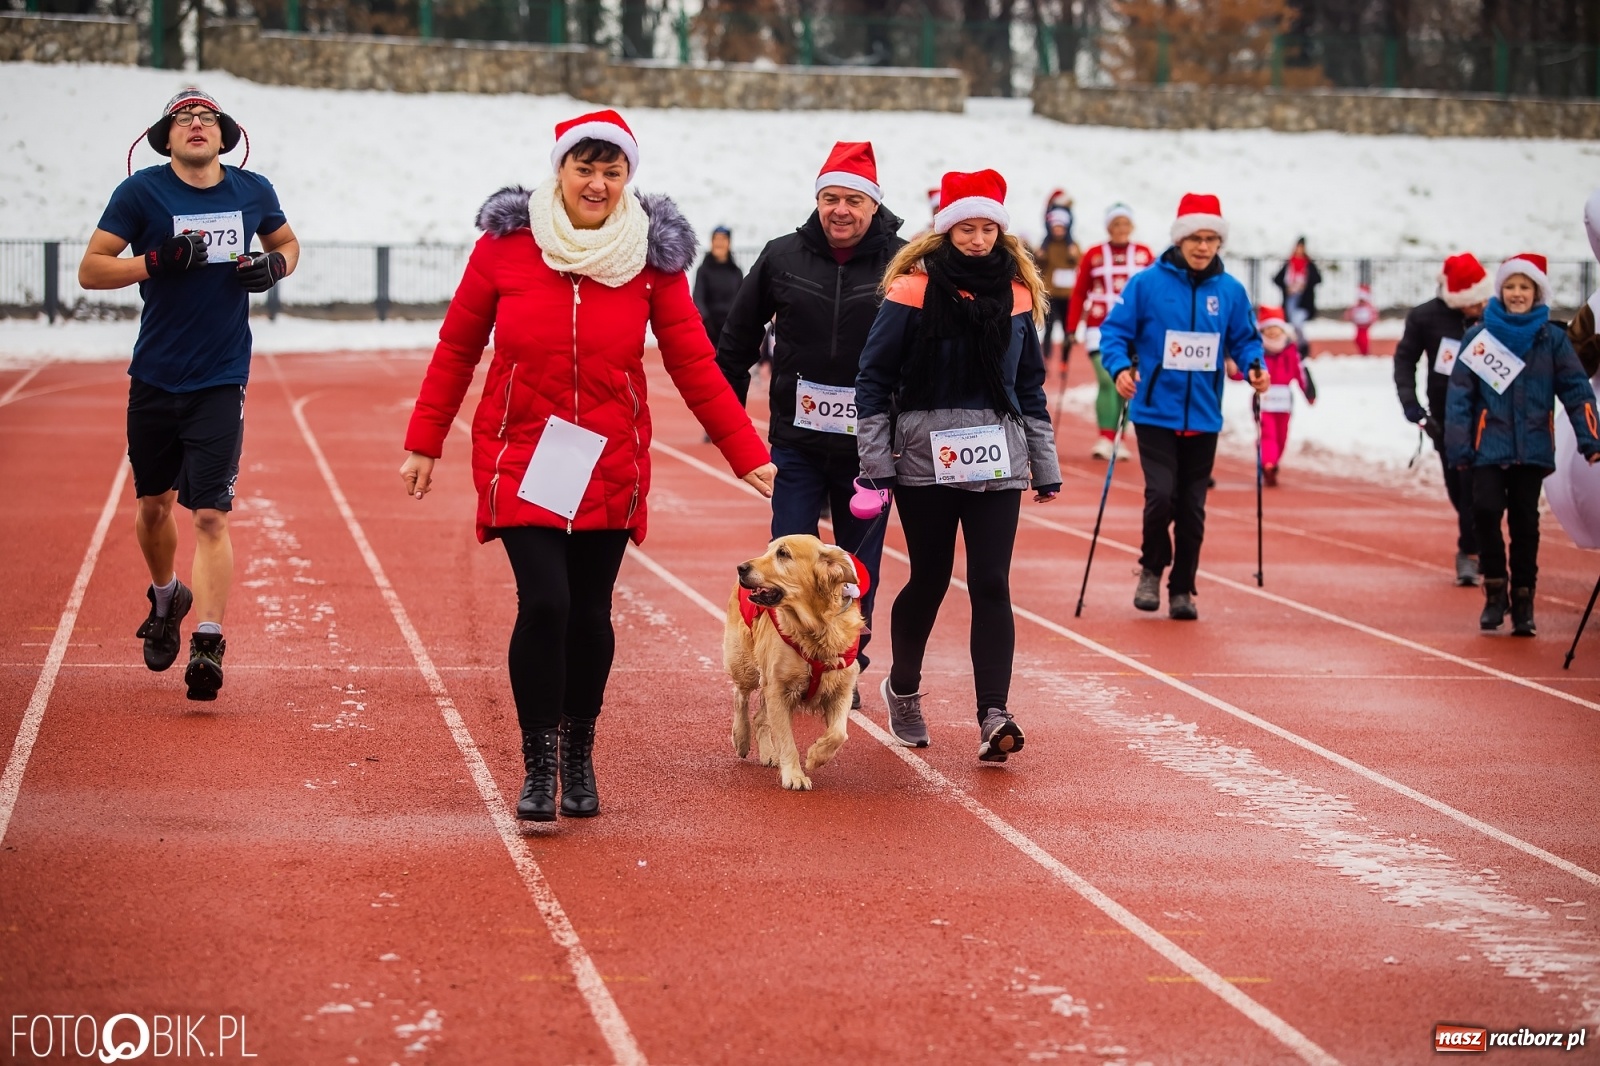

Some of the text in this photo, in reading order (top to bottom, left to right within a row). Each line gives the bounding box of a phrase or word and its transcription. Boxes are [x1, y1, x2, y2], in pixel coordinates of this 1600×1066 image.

[1184, 345, 1211, 358] 061
[1483, 353, 1511, 380] 022
[818, 401, 857, 418] 025
[960, 444, 1002, 465] 020
